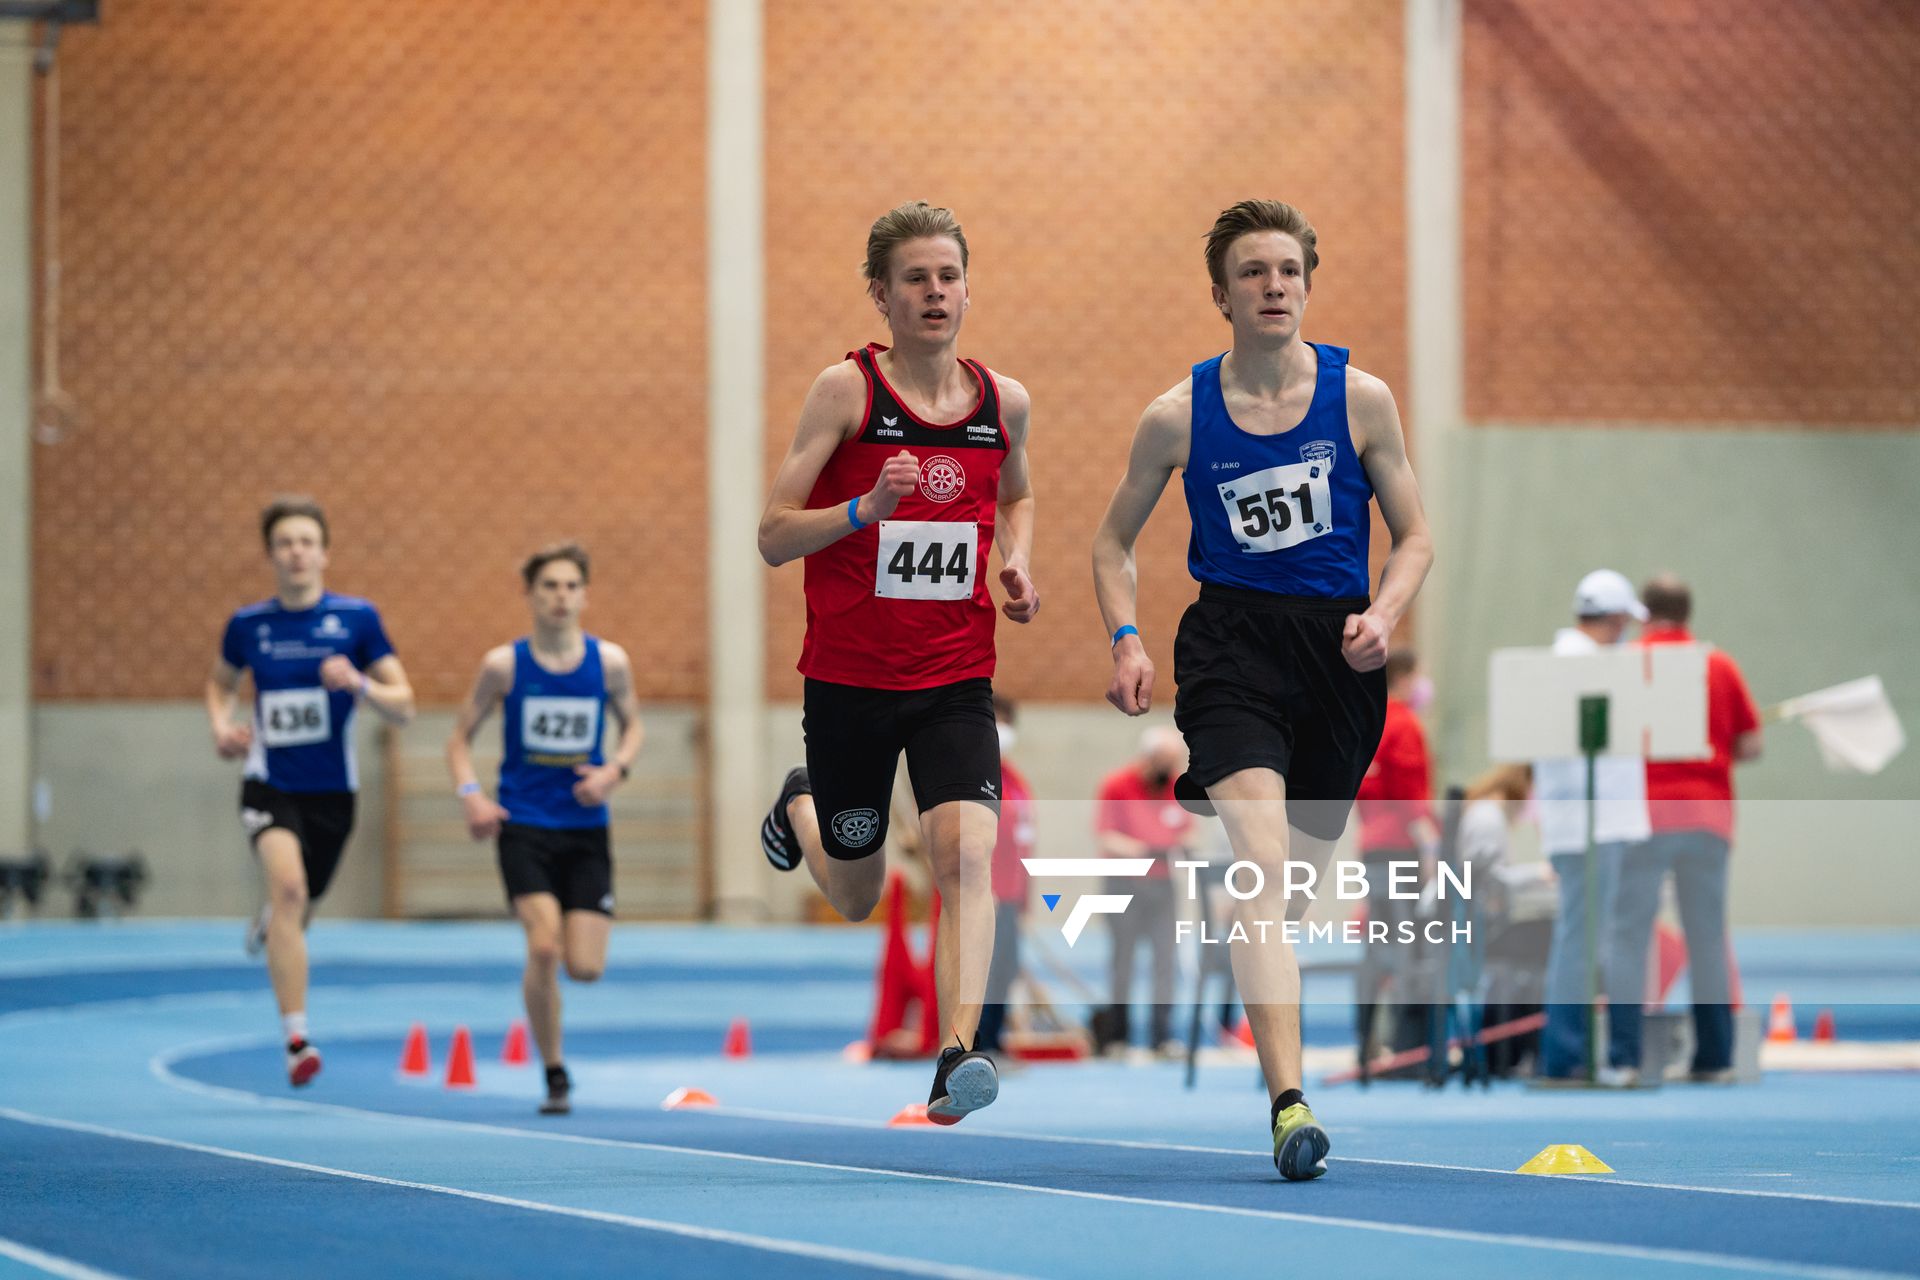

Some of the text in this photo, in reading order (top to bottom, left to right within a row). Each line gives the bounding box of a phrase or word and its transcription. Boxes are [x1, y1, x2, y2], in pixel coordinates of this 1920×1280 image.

[877, 428, 904, 437] erima
[1236, 483, 1314, 538] 551
[887, 541, 968, 584] 444
[269, 702, 321, 731] 436
[531, 711, 590, 738] 428
